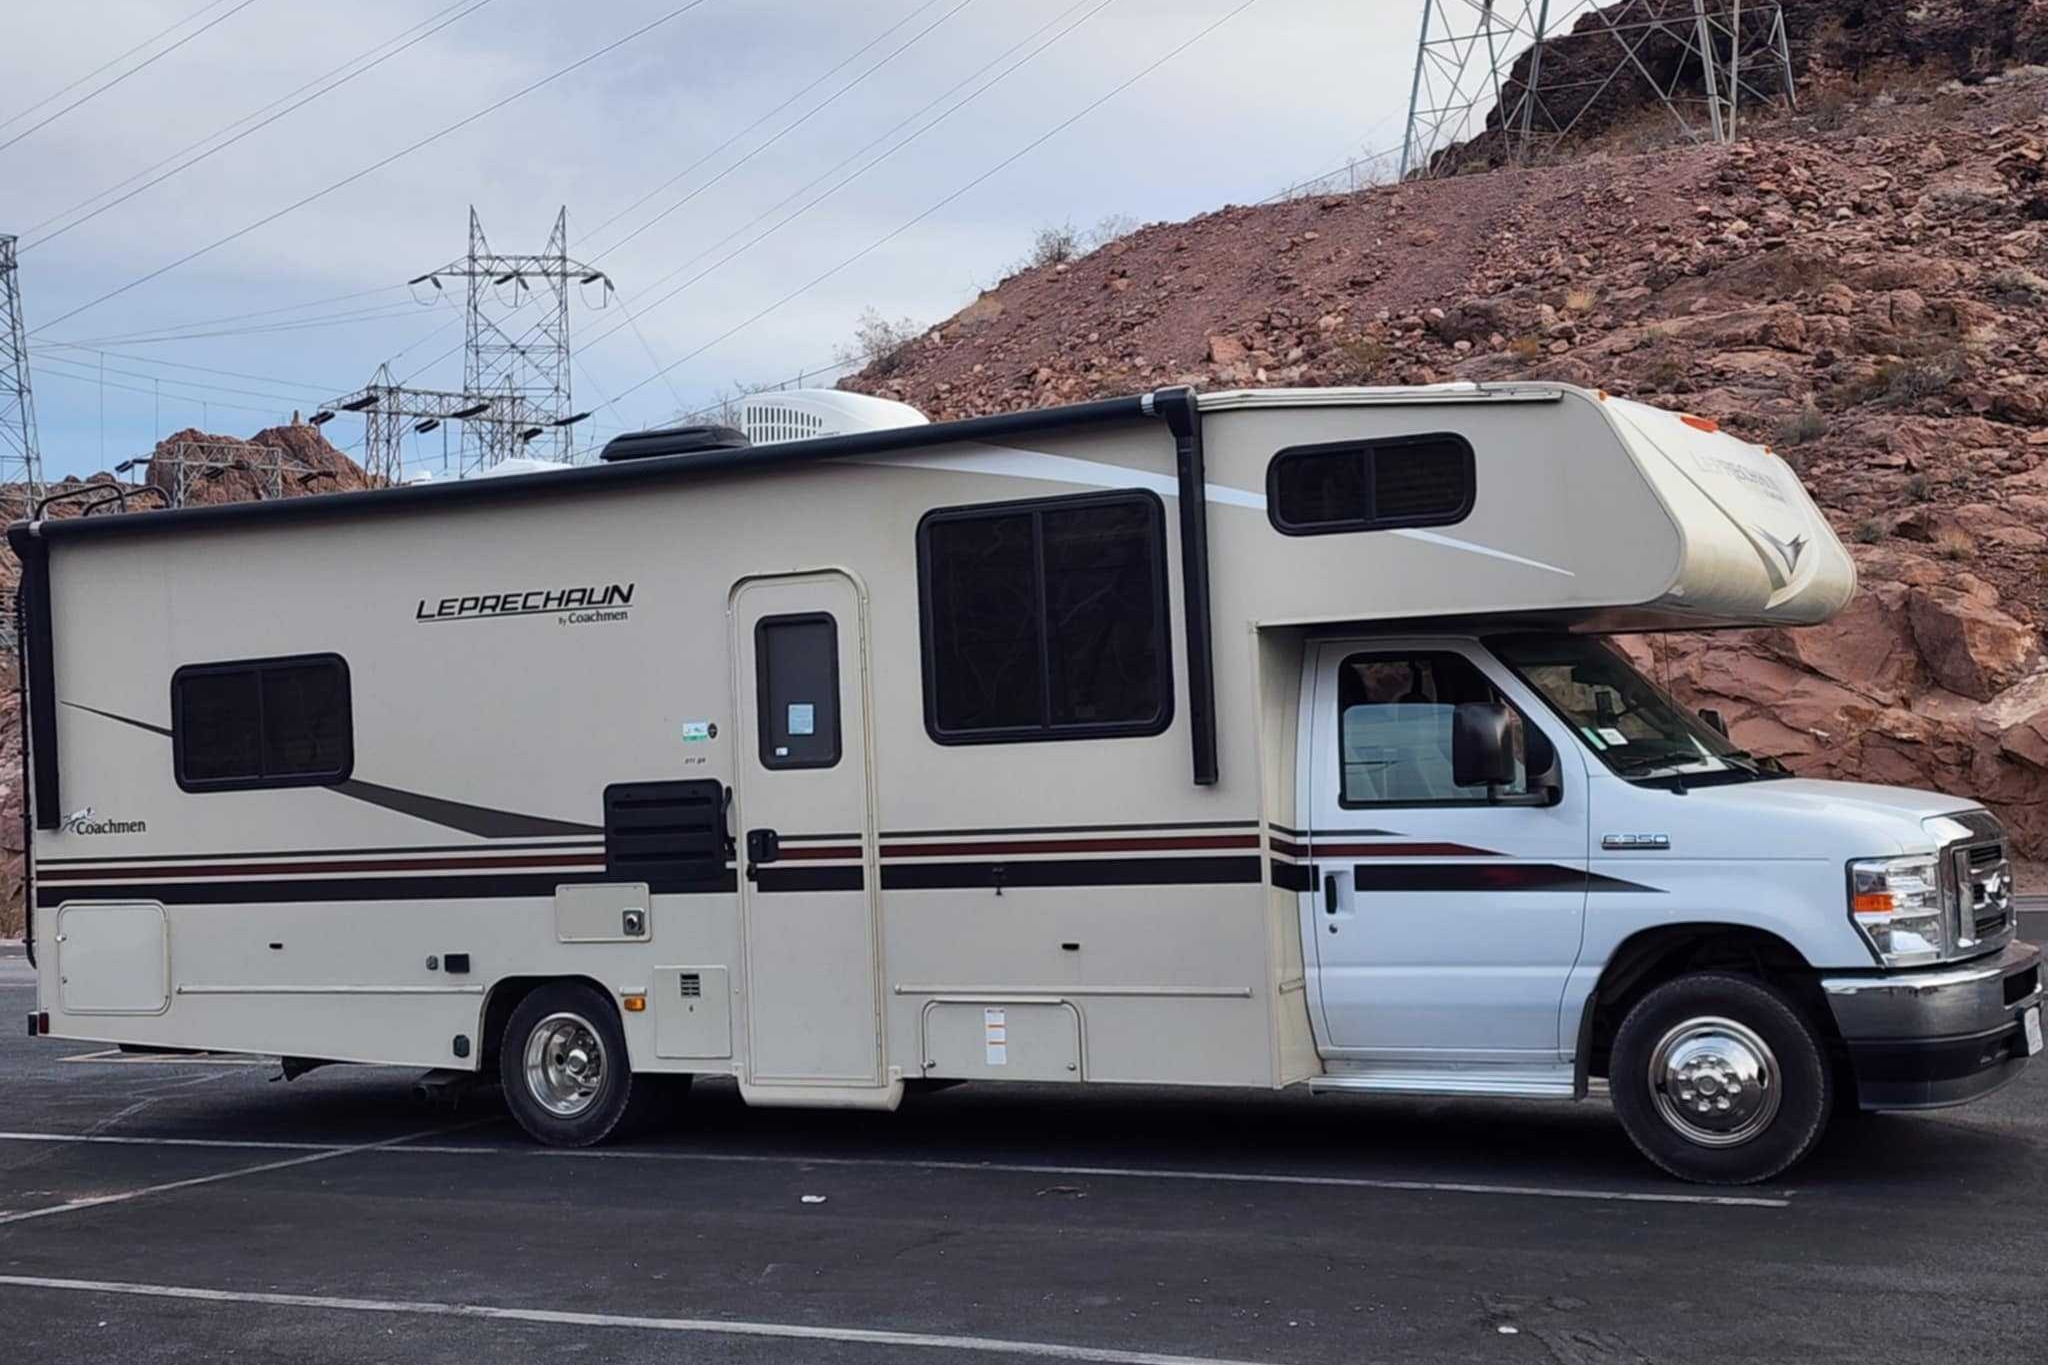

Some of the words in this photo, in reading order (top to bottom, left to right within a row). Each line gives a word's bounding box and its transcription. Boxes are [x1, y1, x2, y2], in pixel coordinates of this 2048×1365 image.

[416, 583, 635, 620] LEPRECHAUN
[568, 610, 629, 624] Coachmen
[76, 818, 146, 835] Coachmen
